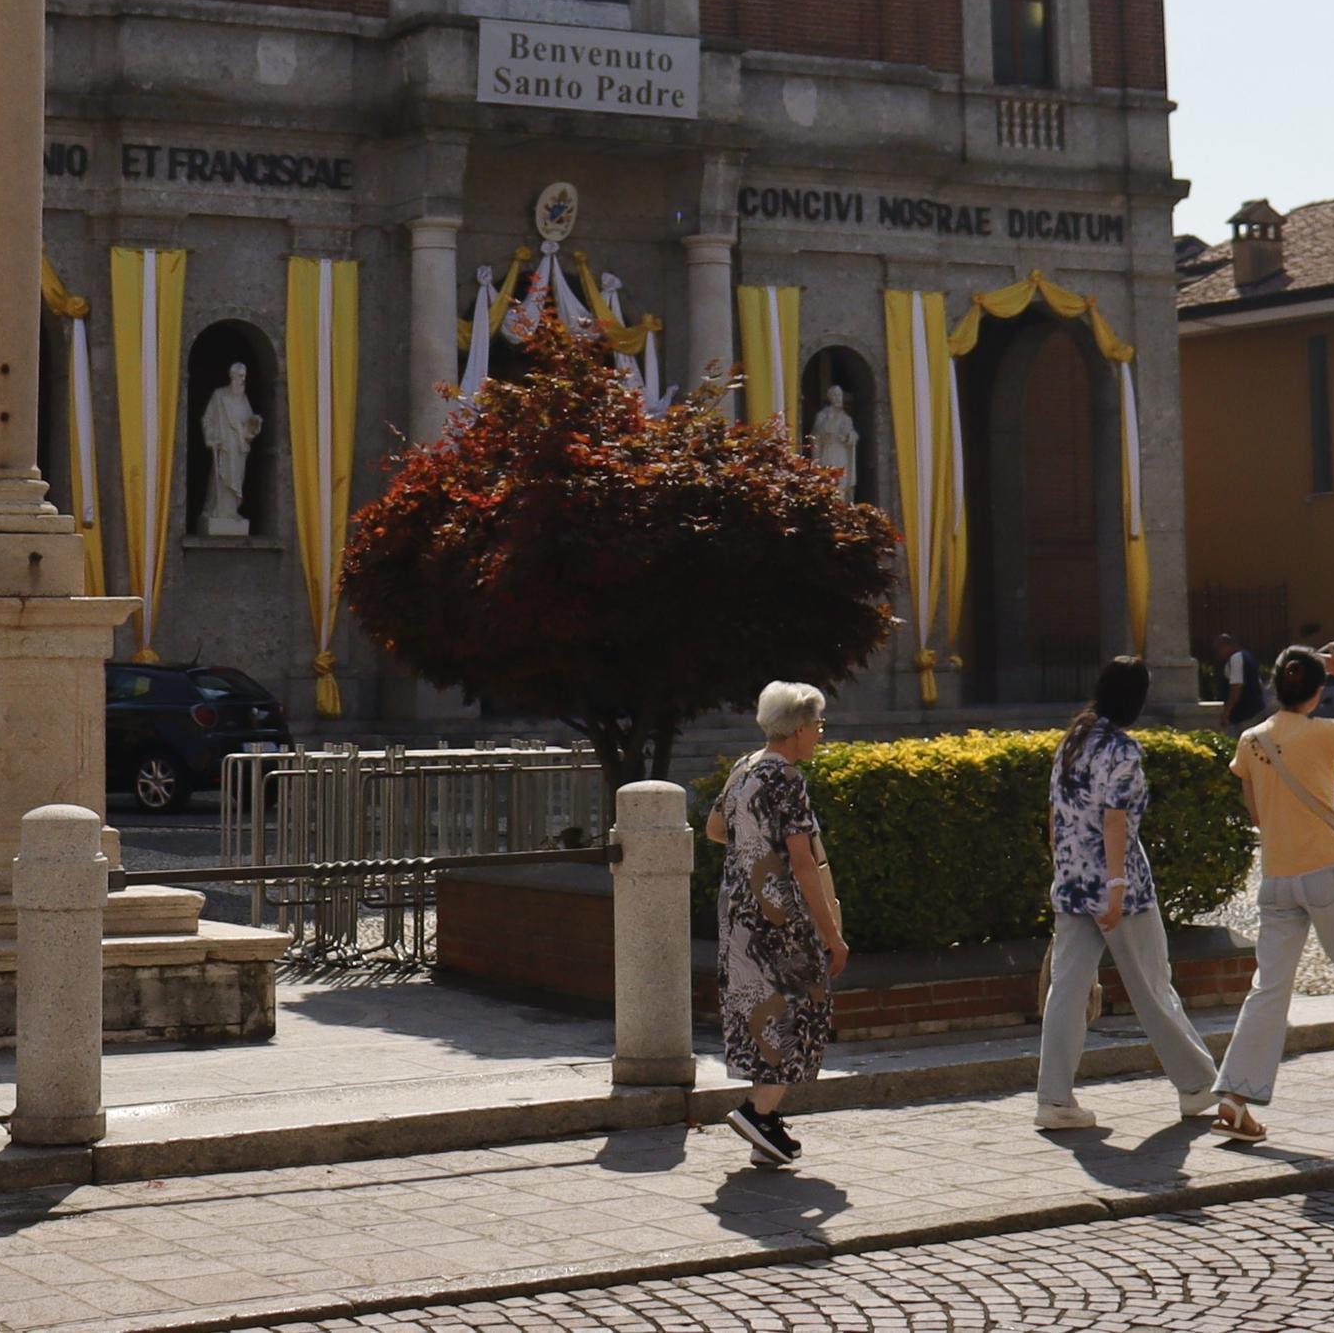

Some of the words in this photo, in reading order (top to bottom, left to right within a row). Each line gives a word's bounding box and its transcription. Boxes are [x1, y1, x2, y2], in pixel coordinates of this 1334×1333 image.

[509, 33, 673, 72] Benvenuto
[493, 67, 583, 99] Santo
[596, 75, 685, 108] Padre
[122, 144, 161, 179] ET
[168, 147, 353, 190] FRANCISCAE
[738, 185, 863, 223] CONCIVI
[1008, 207, 1123, 243] DICATUM
